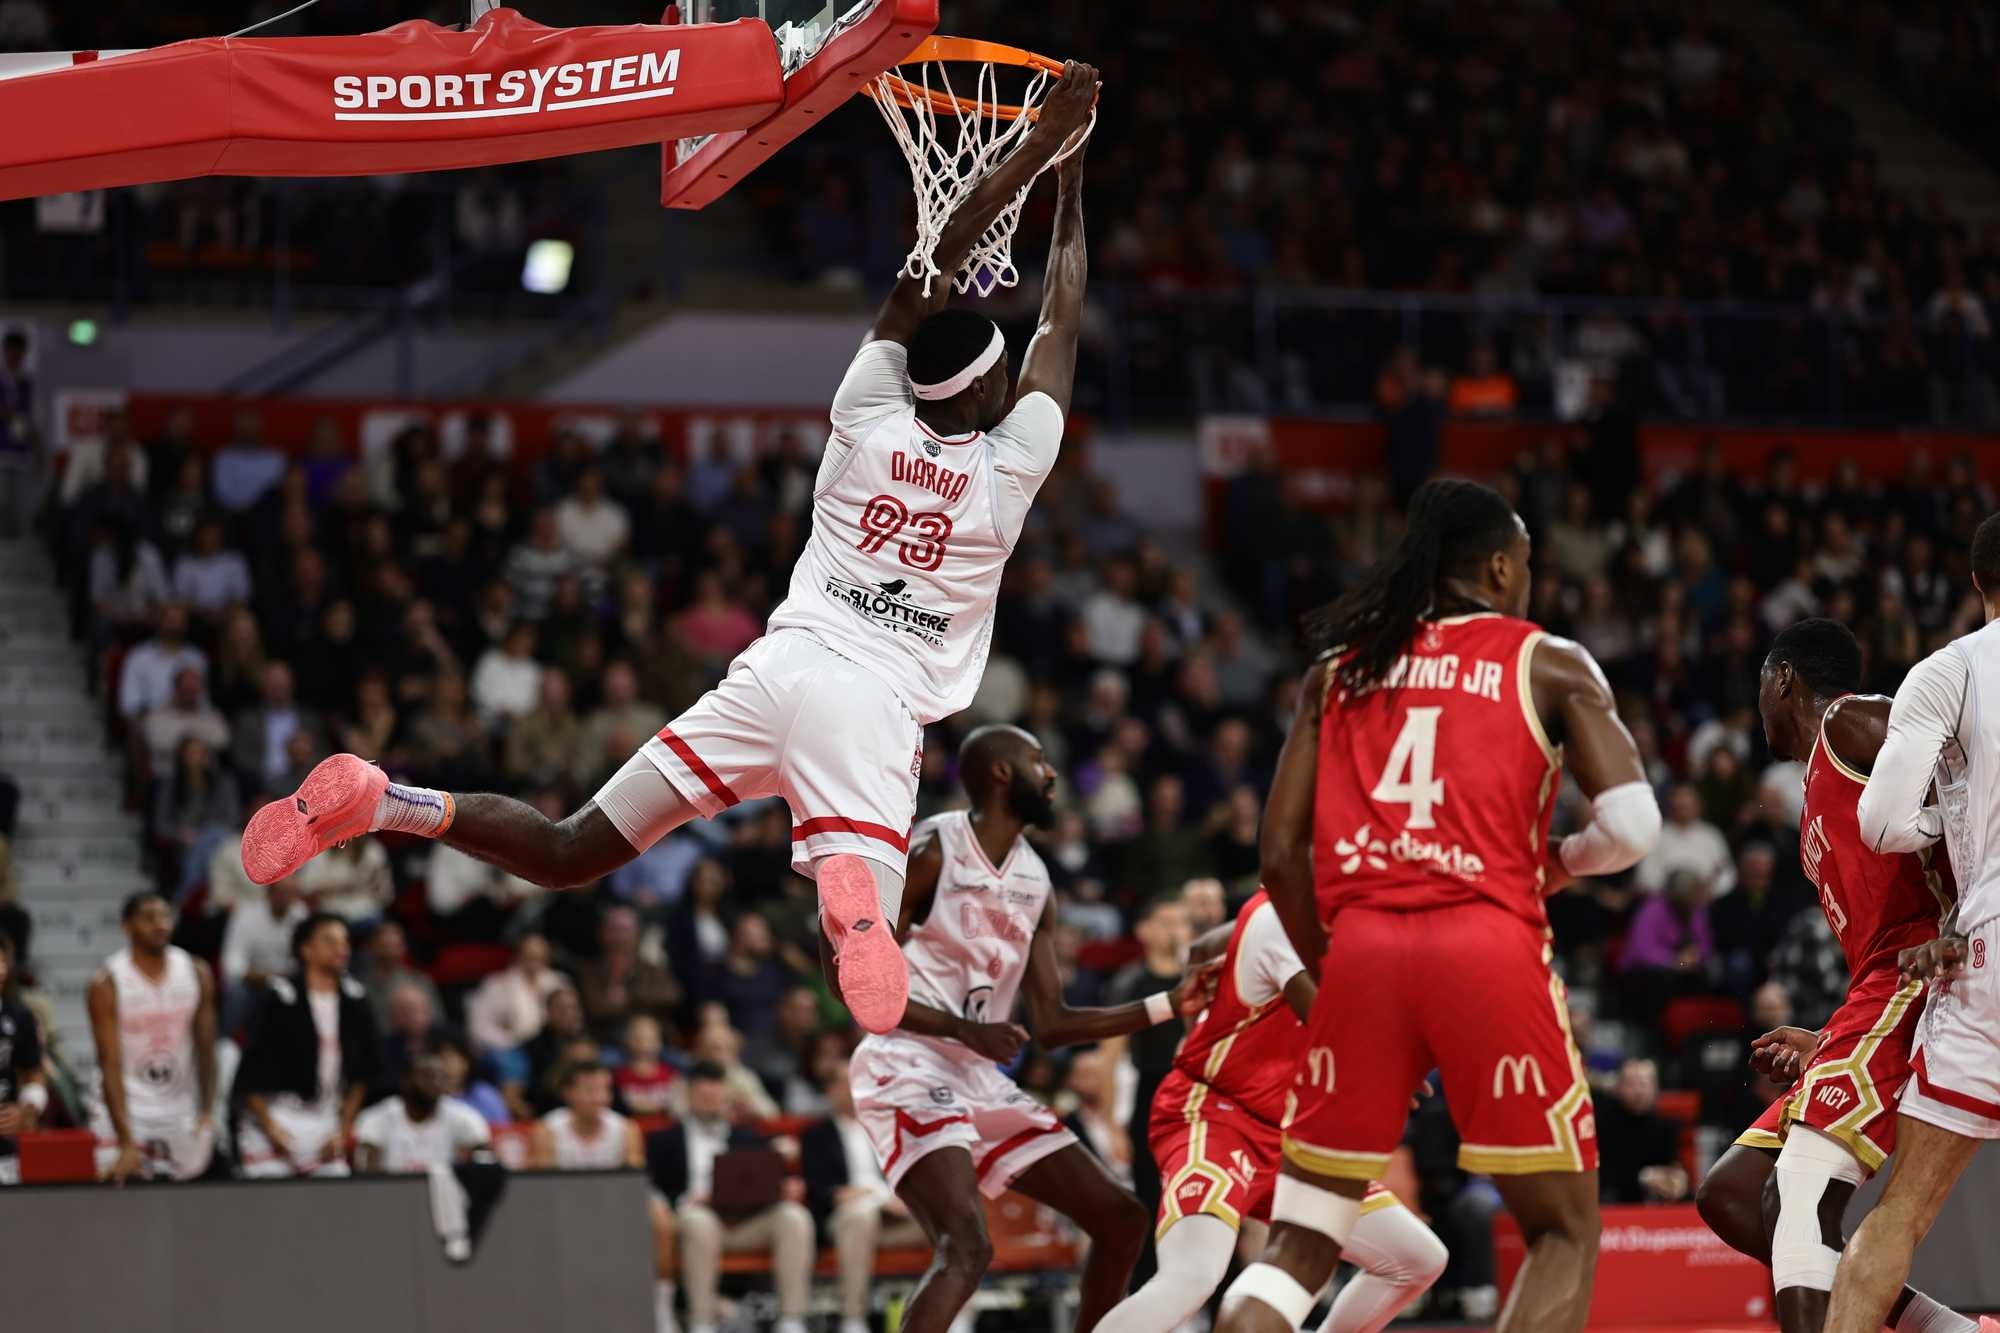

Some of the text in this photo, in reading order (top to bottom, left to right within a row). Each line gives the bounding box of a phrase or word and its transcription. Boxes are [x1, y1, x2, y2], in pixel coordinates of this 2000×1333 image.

[891, 451, 969, 502] DIARRA
[856, 494, 953, 572] 93
[1462, 660, 1503, 702] JR
[1370, 706, 1444, 829] 4
[1815, 1085, 1850, 1110] NCY
